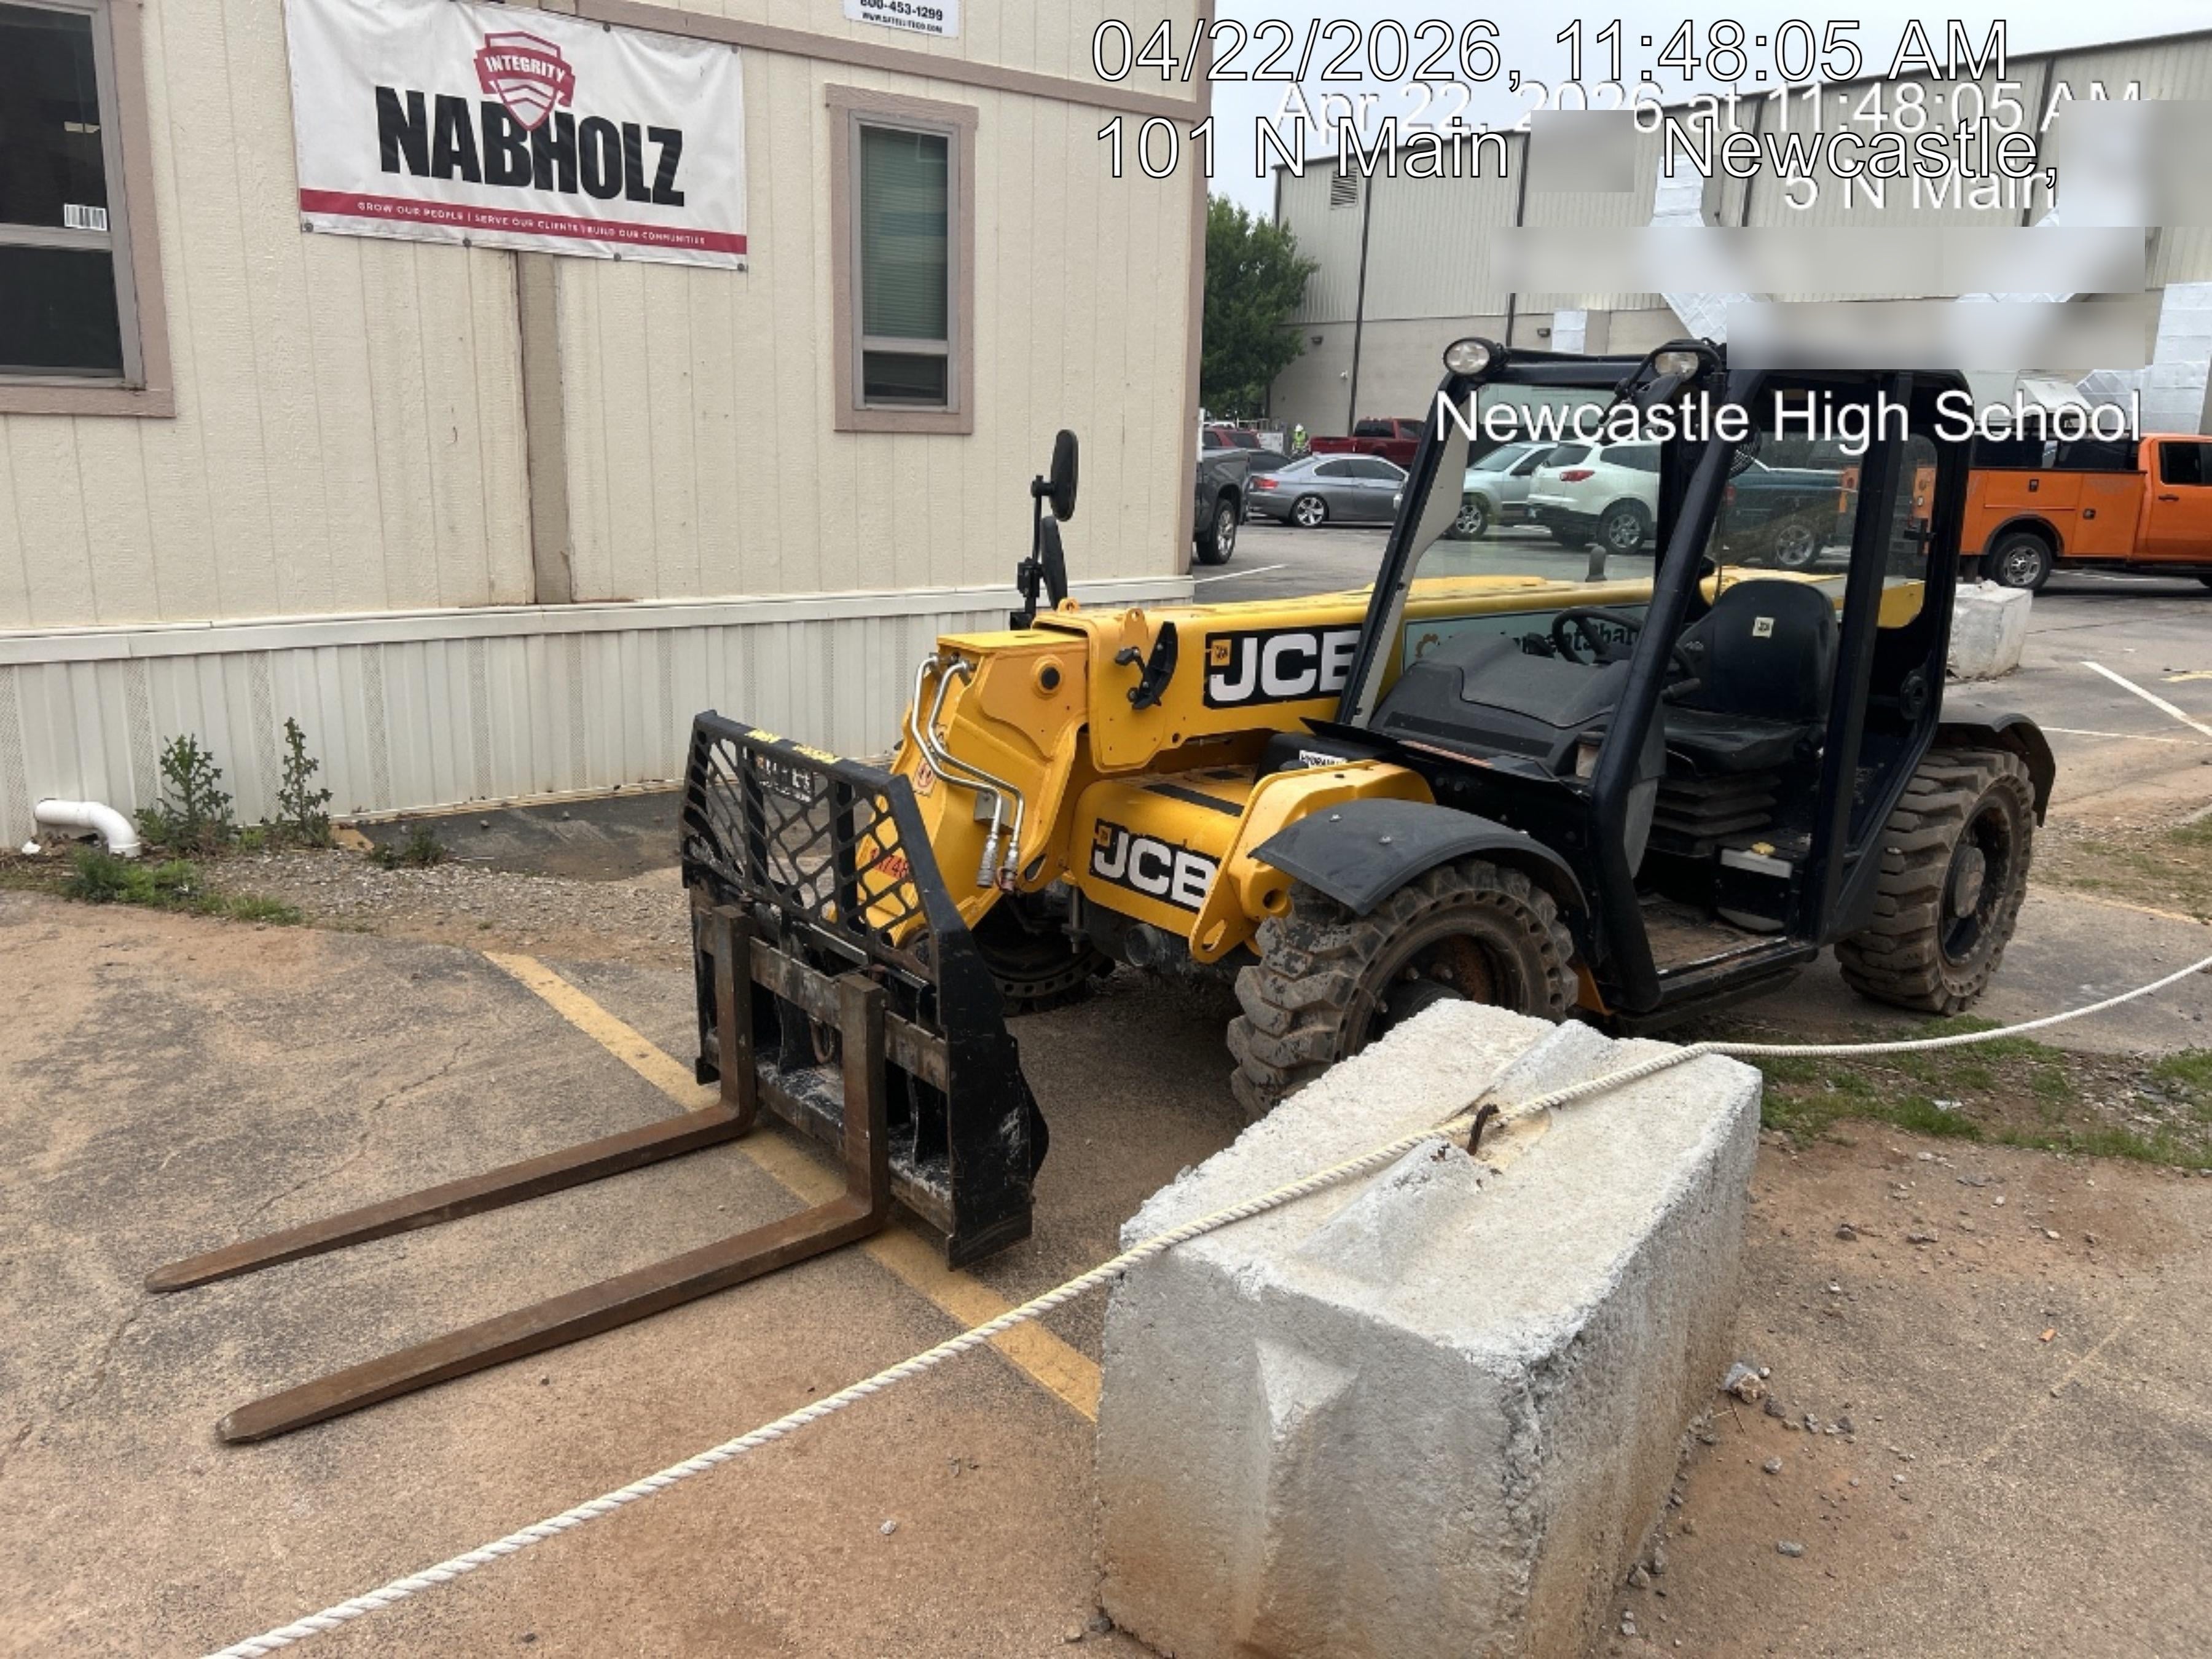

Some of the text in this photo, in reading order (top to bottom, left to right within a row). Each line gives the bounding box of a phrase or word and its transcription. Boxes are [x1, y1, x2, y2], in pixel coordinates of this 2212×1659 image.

[484, 54, 566, 84] INTEGRITY
[375, 85, 685, 207] NABHOLZ
[358, 202, 705, 245] GROW OUR PEOPLE SERVE OUR CLIENTS BUILD OUR COMMUNITIES
[1094, 831, 1218, 908] JCB
